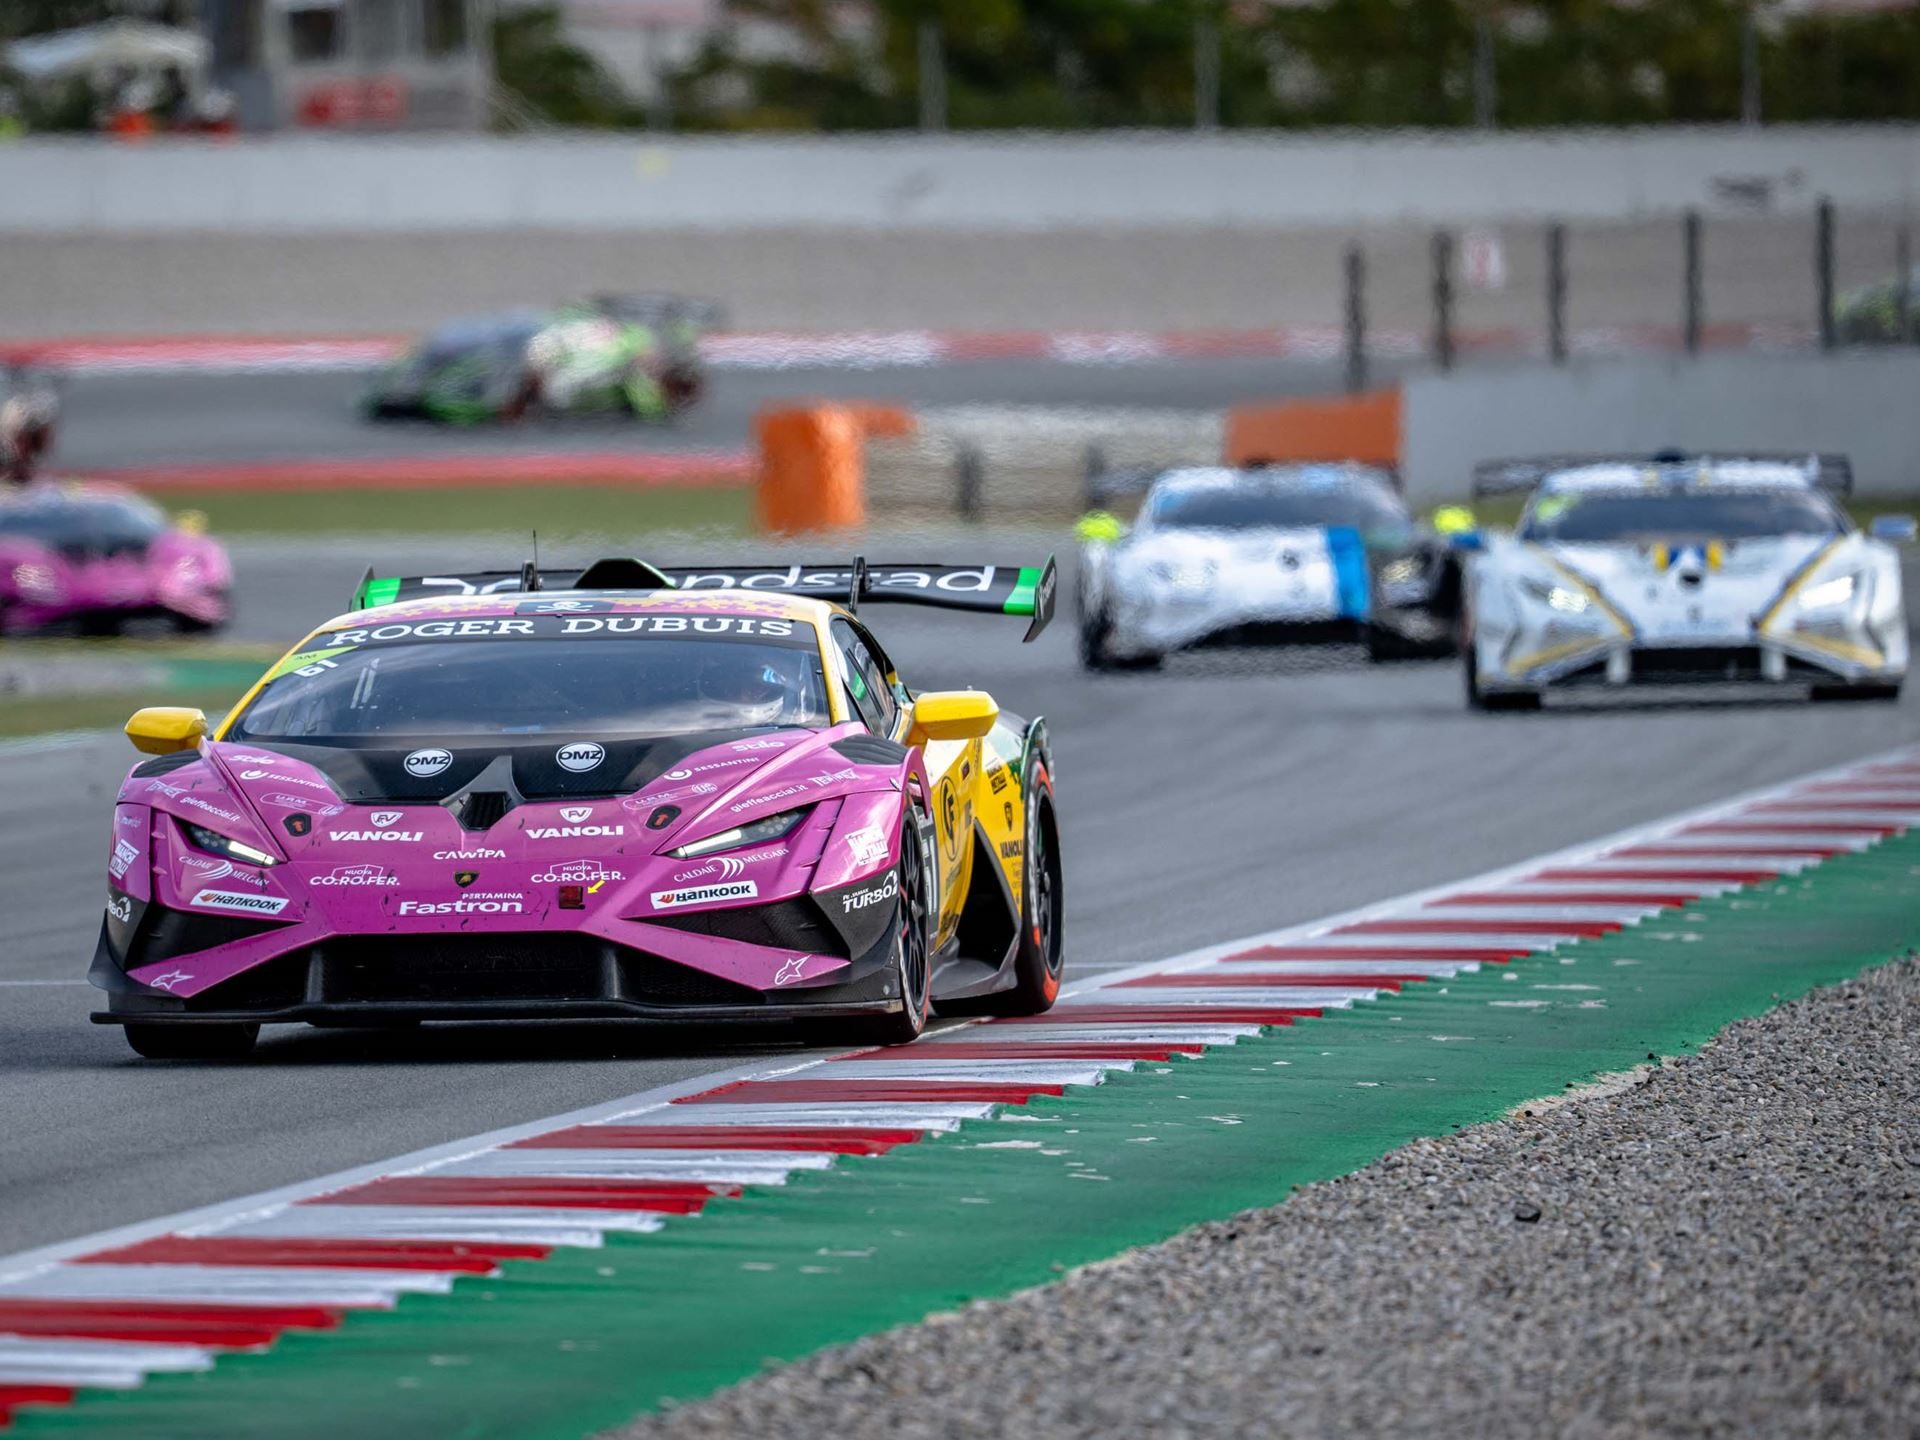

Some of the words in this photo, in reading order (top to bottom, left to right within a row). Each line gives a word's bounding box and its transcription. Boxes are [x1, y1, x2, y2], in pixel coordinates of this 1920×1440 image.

[326, 619, 535, 647] ROGER
[561, 617, 793, 636] DUBUIS
[406, 755, 450, 766] OMZ
[559, 750, 603, 761] OMZ
[694, 756, 759, 772] SESSANTINI
[267, 773, 326, 790] SESSANTINI
[329, 831, 424, 842] VANOLI
[525, 825, 624, 839] VANOLI
[673, 864, 720, 882] CALDAIE
[462, 892, 524, 900] PERTAMINA
[399, 901, 522, 915] Fastron
